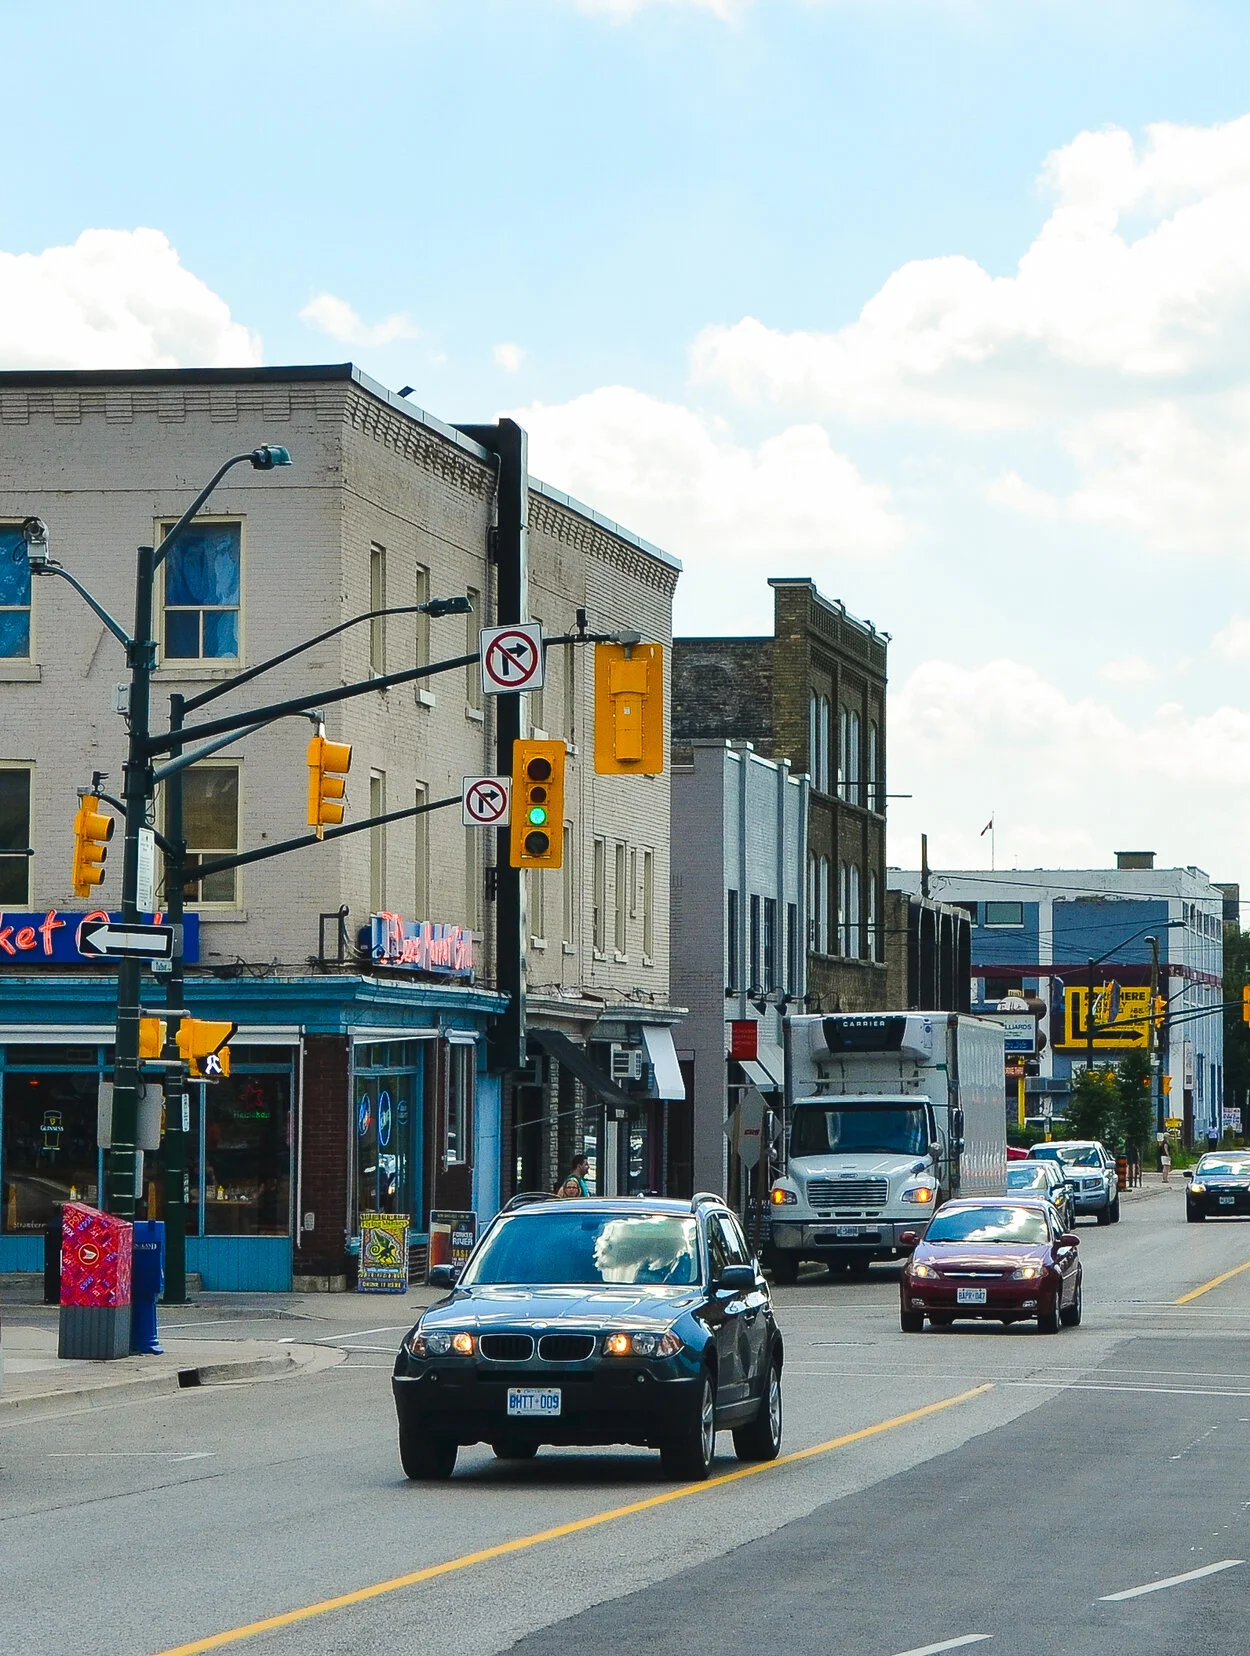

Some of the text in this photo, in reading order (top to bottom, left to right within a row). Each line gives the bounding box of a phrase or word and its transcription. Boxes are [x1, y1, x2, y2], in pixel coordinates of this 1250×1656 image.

[452, 1237, 473, 1246] RIVER
[509, 1394, 560, 1409] BHTT 009
